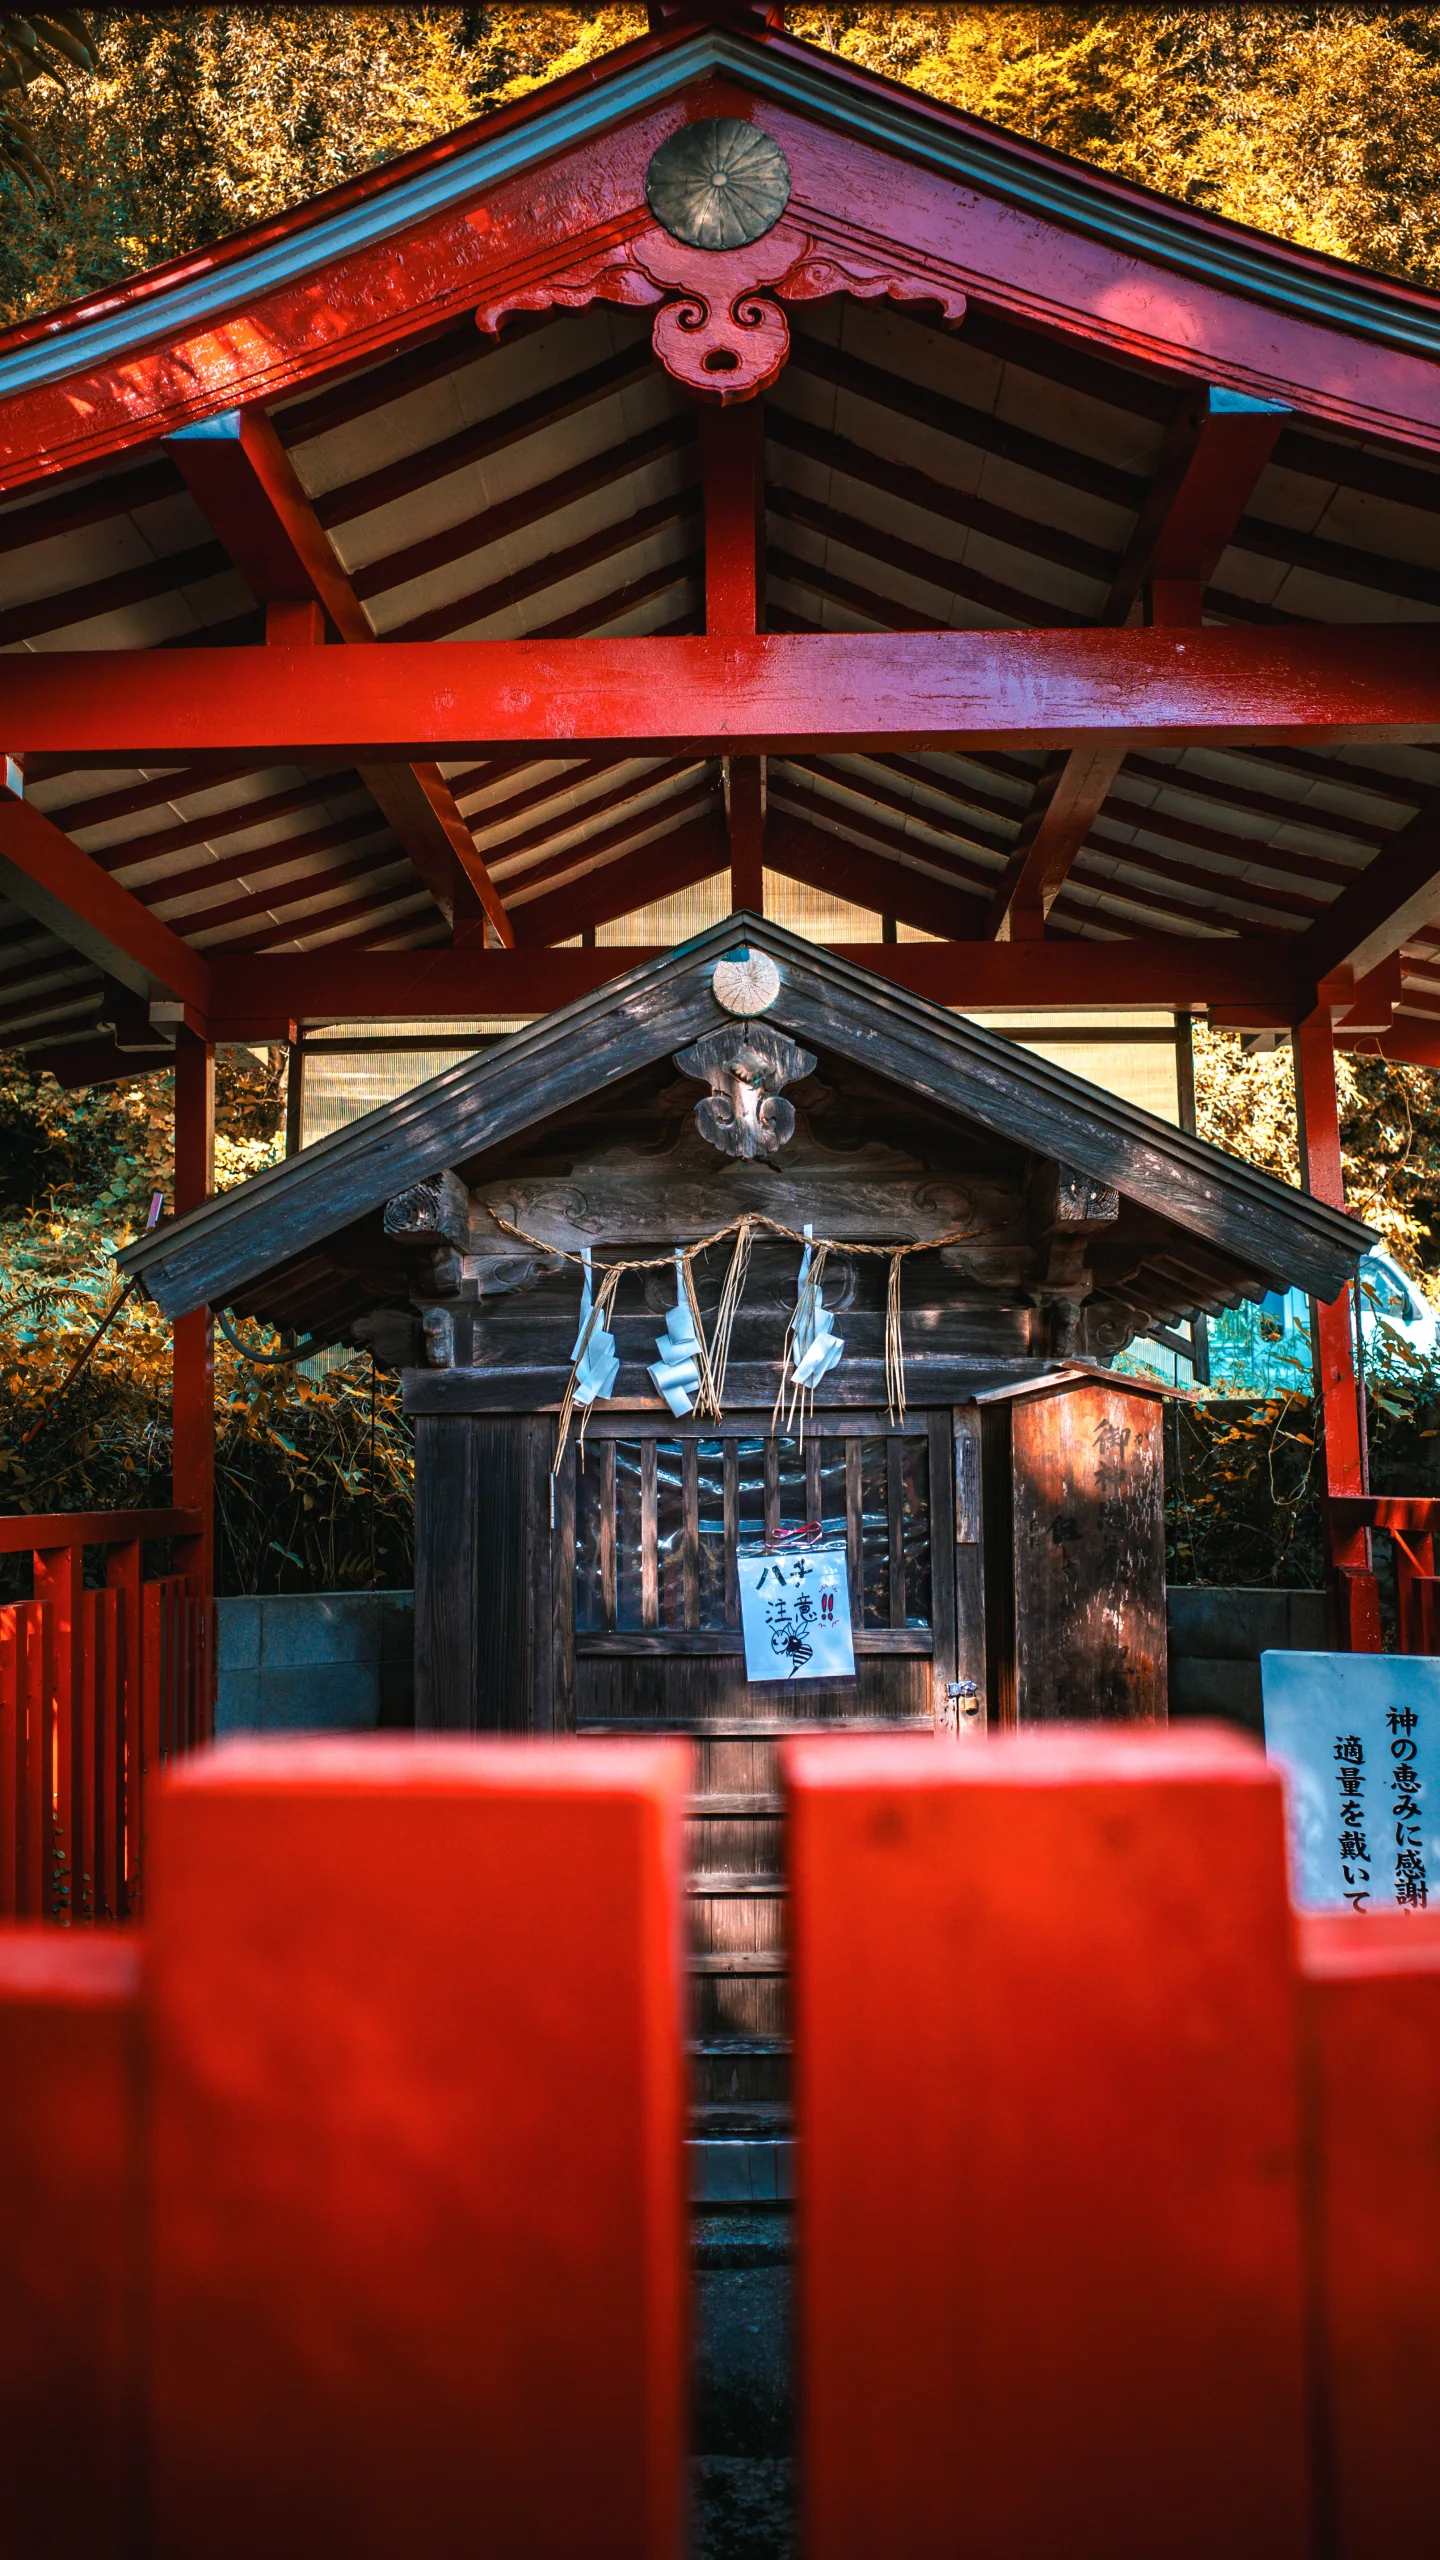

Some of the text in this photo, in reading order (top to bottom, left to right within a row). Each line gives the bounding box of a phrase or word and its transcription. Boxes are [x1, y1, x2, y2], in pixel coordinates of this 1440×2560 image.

[755, 1558, 814, 1591] ハチ
[1333, 1735, 1372, 1915] 適量を戴いて
[1386, 1705, 1428, 1917] 神の恵みに感謝
